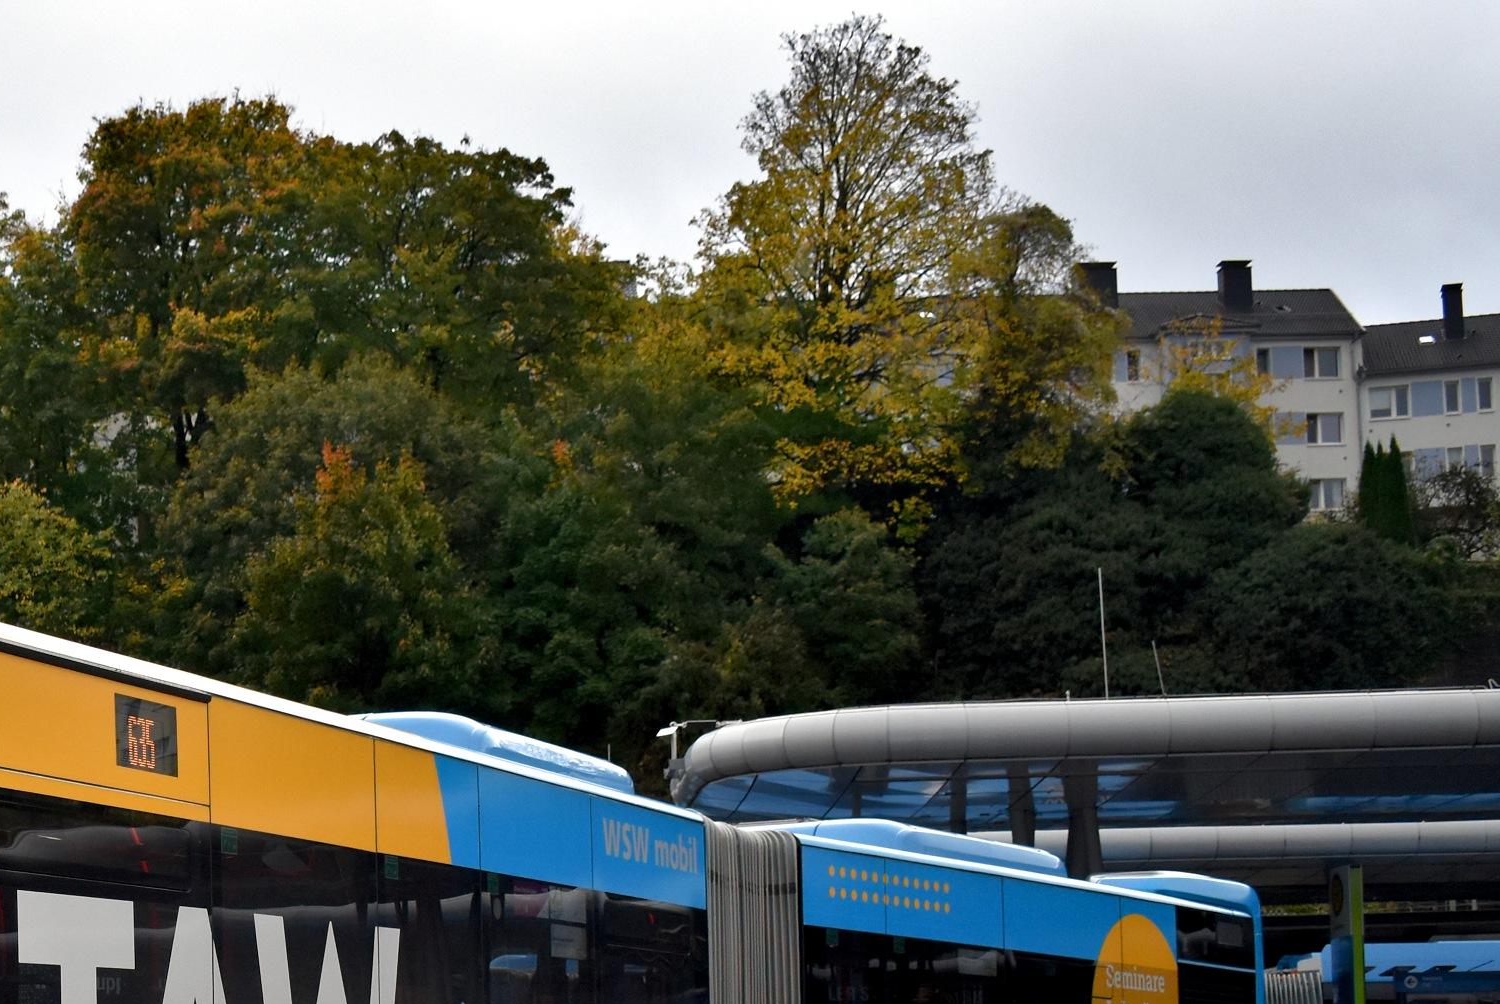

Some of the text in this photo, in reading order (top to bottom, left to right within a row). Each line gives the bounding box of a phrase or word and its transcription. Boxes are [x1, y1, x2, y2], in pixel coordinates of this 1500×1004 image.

[127, 715, 156, 769] 635
[602, 817, 697, 874] WSW mobil
[1106, 964, 1165, 993] Seminare
